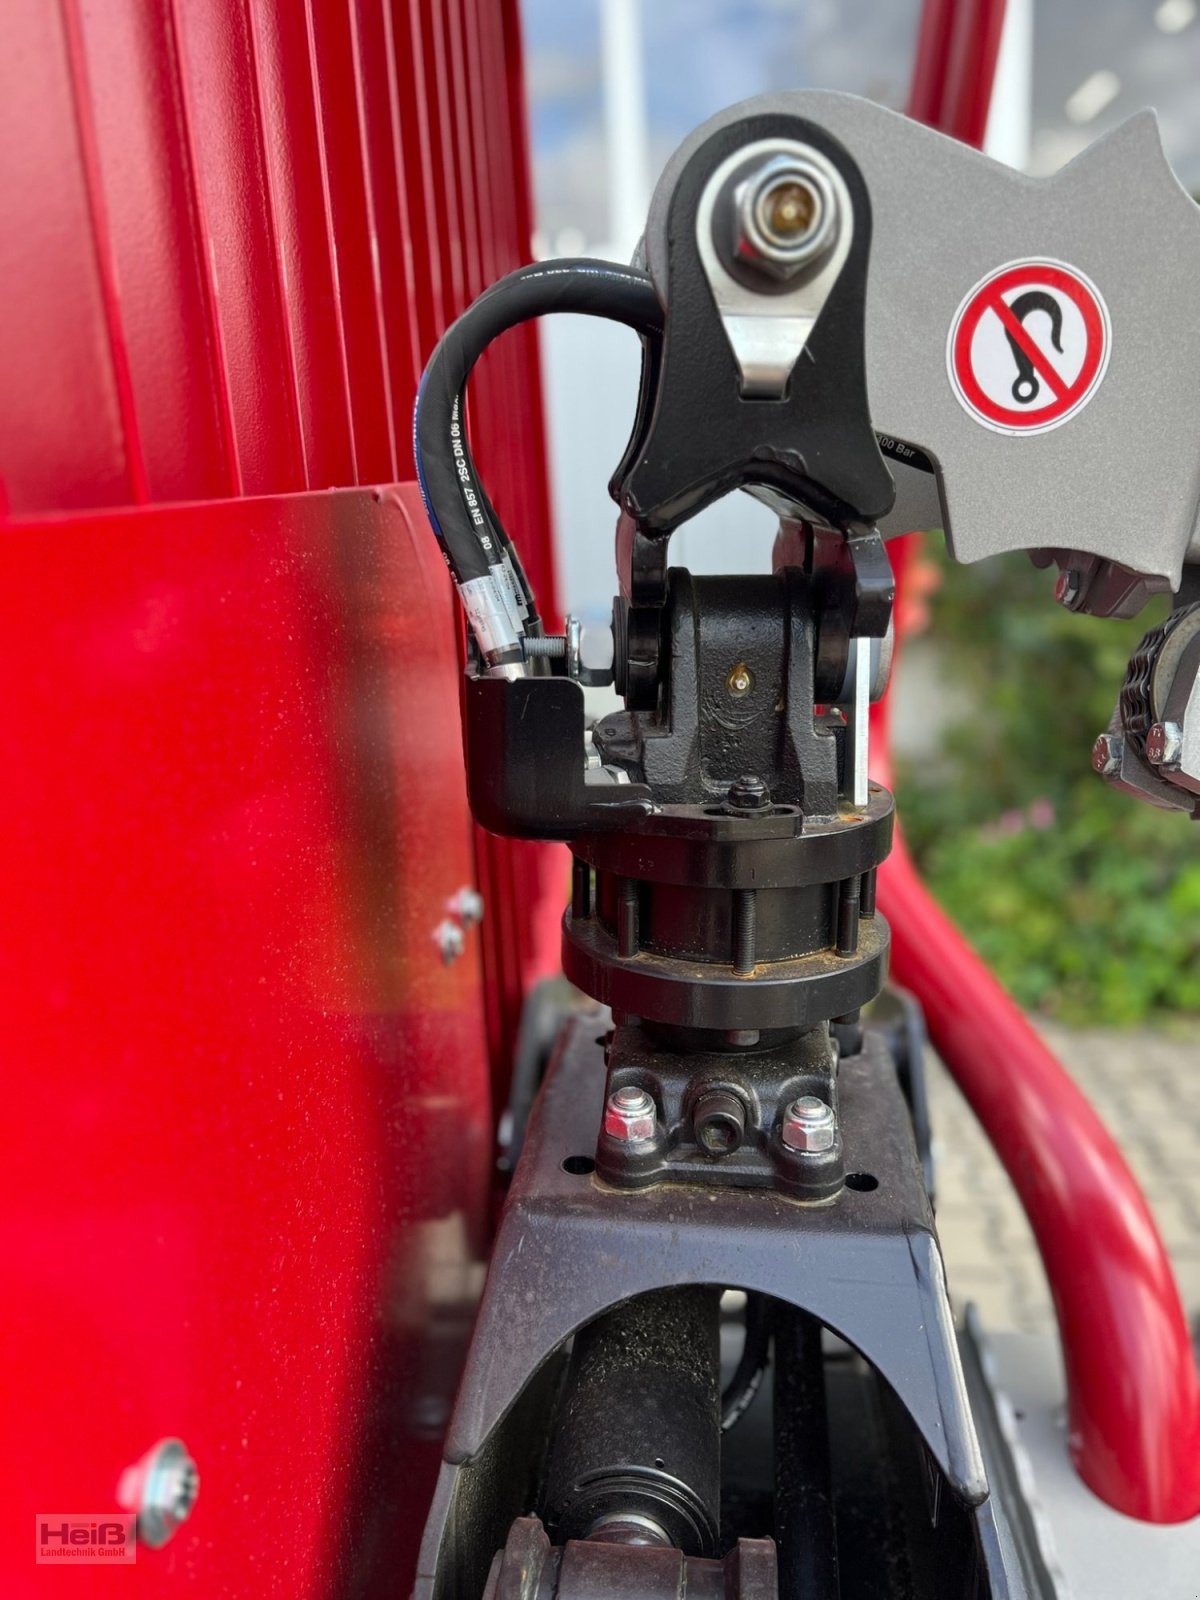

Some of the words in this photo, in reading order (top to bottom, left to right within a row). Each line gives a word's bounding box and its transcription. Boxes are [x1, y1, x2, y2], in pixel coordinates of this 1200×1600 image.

[451, 423, 461, 437] 06
[452, 439, 464, 456] DN
[896, 443, 916, 458] Bar
[456, 459, 470, 482] 2SC
[464, 487, 478, 506] 857
[471, 509, 484, 525] EN
[481, 535, 492, 550] 08
